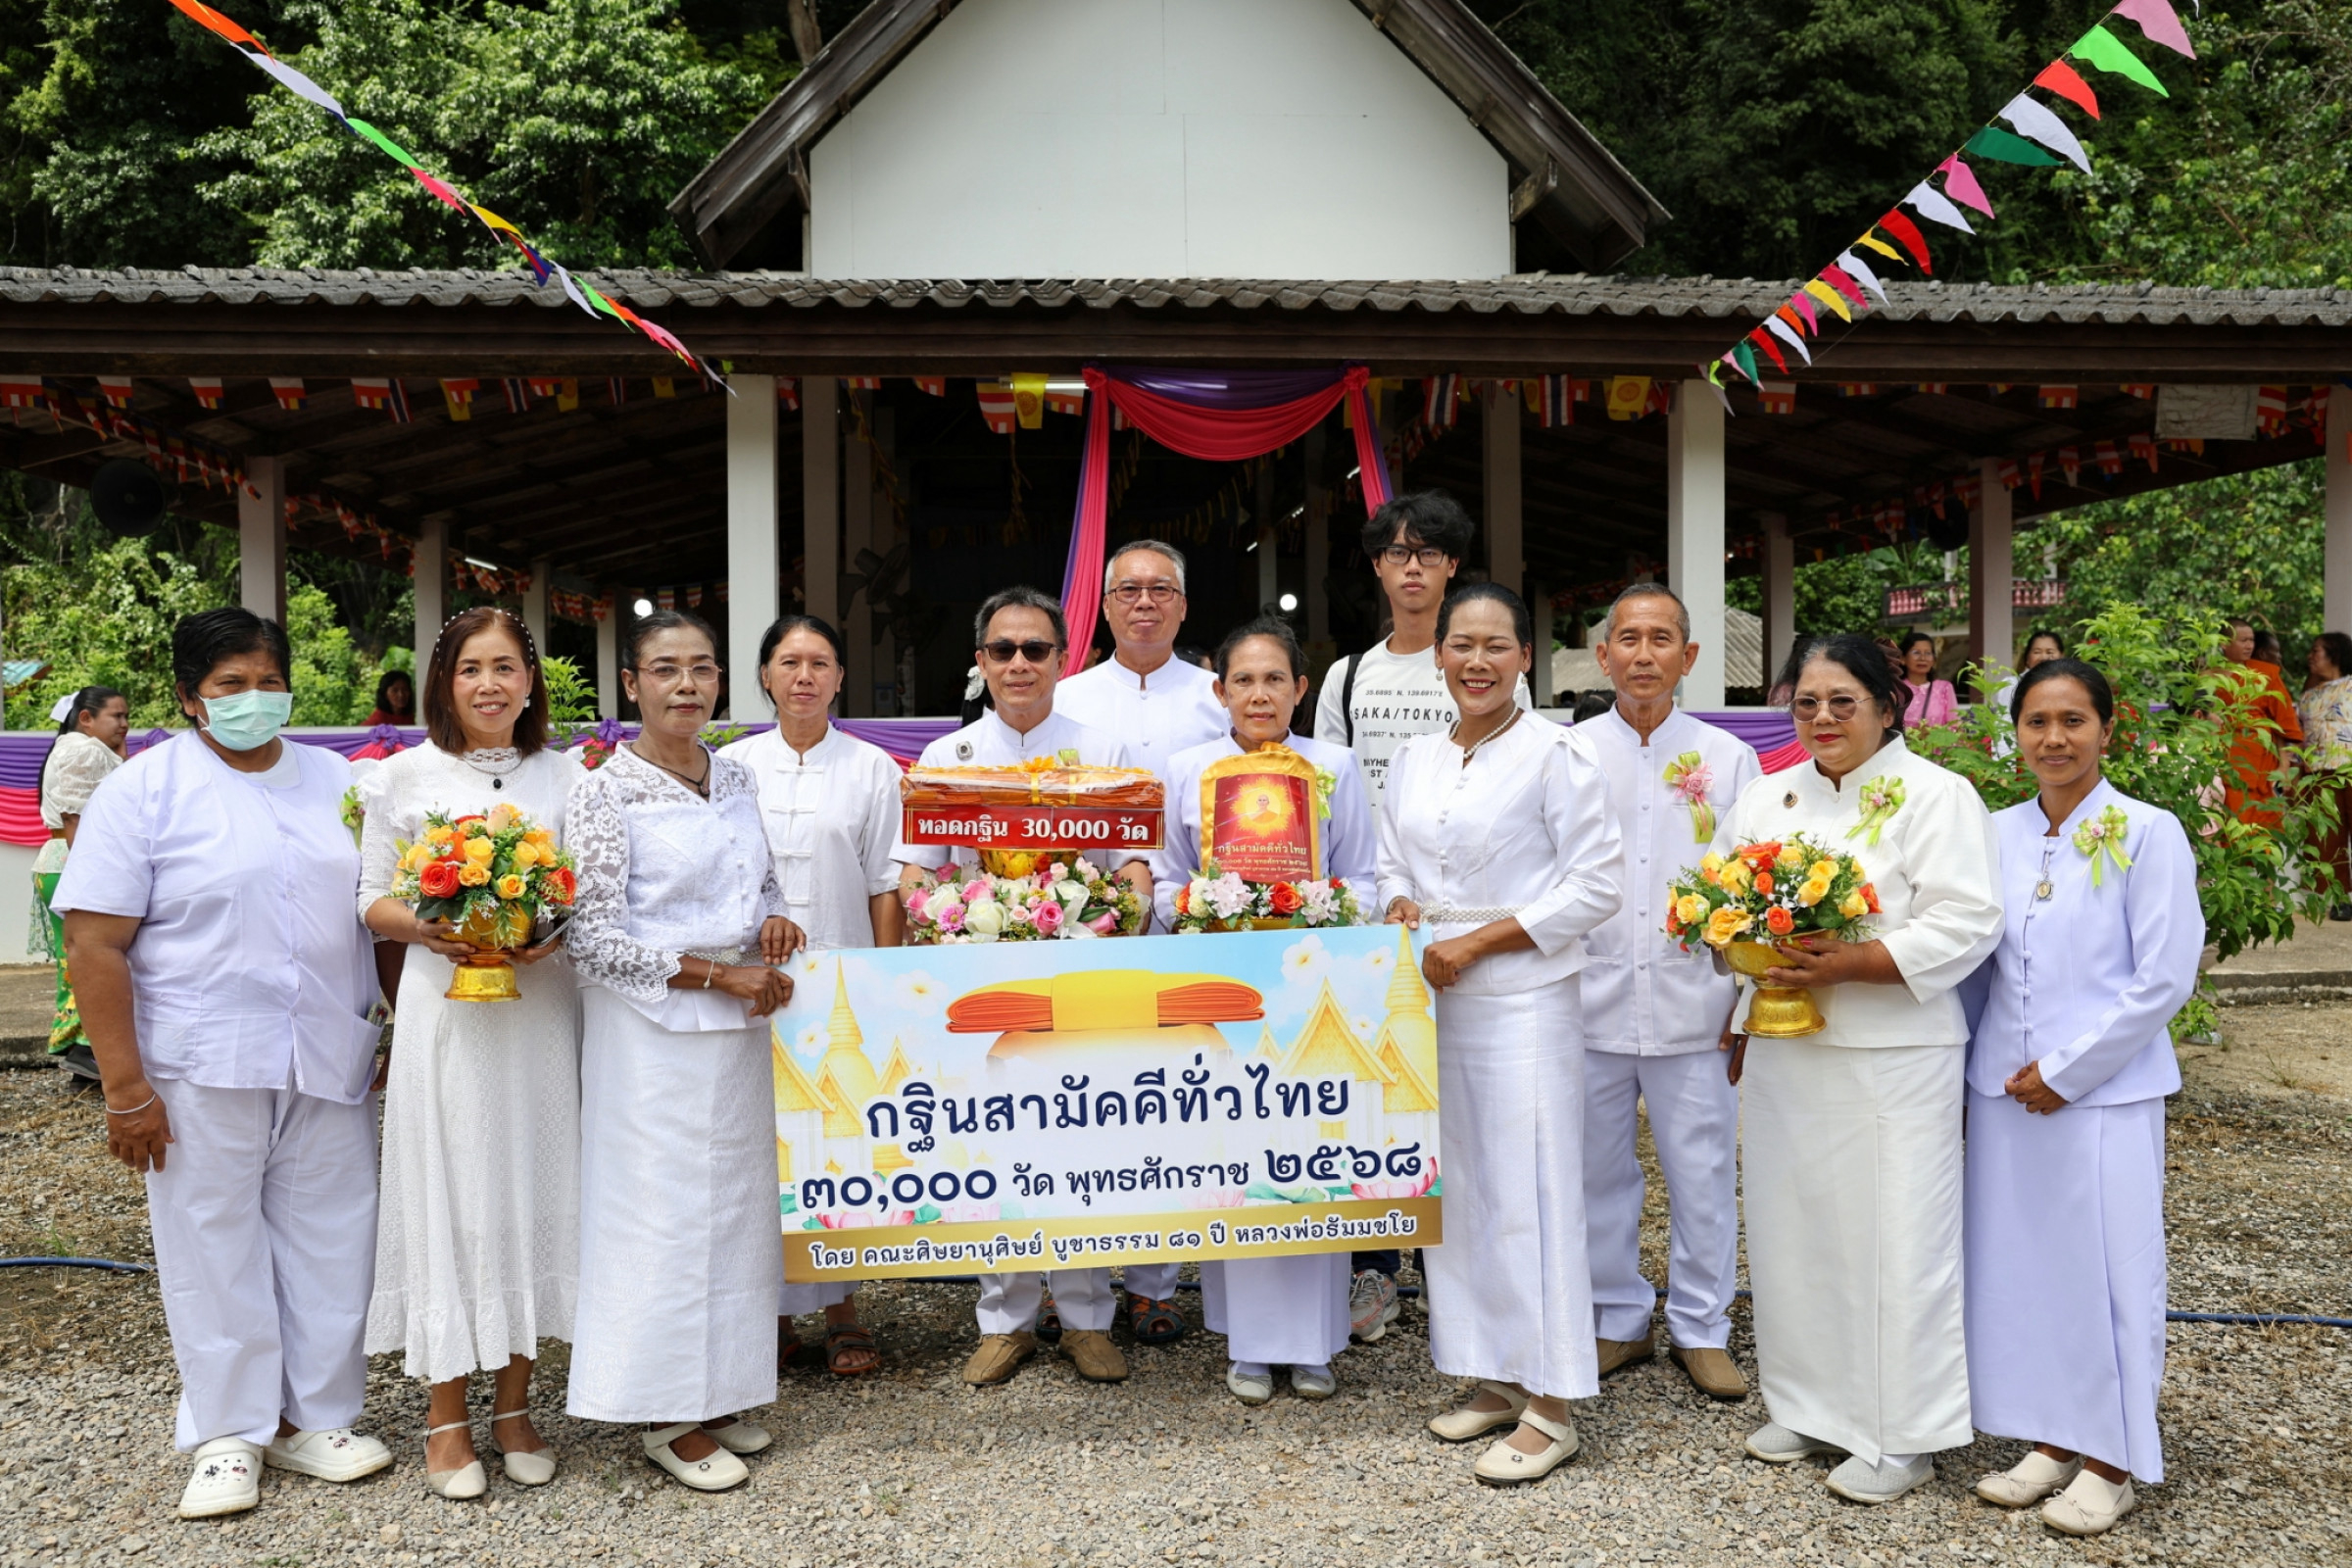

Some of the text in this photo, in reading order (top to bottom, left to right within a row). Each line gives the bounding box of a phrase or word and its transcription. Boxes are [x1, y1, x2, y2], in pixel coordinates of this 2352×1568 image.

[1350, 707, 1453, 723] SAKA/TOKYO
[918, 813, 1149, 843] ทอดกฐิน 30,000 วัด
[866, 1054, 1349, 1153] กฐินสามัคคีทั่วไทย
[802, 1142, 1422, 1213] ๓๐,๐๐๐ วัด พุทธศักราช ๒๕๖๘
[811, 1212, 1416, 1266] โดย คณะศิษยานุศิษย์ บูชาธรรม ๘๑ ปี หลวงพ่อธัมมชโย
